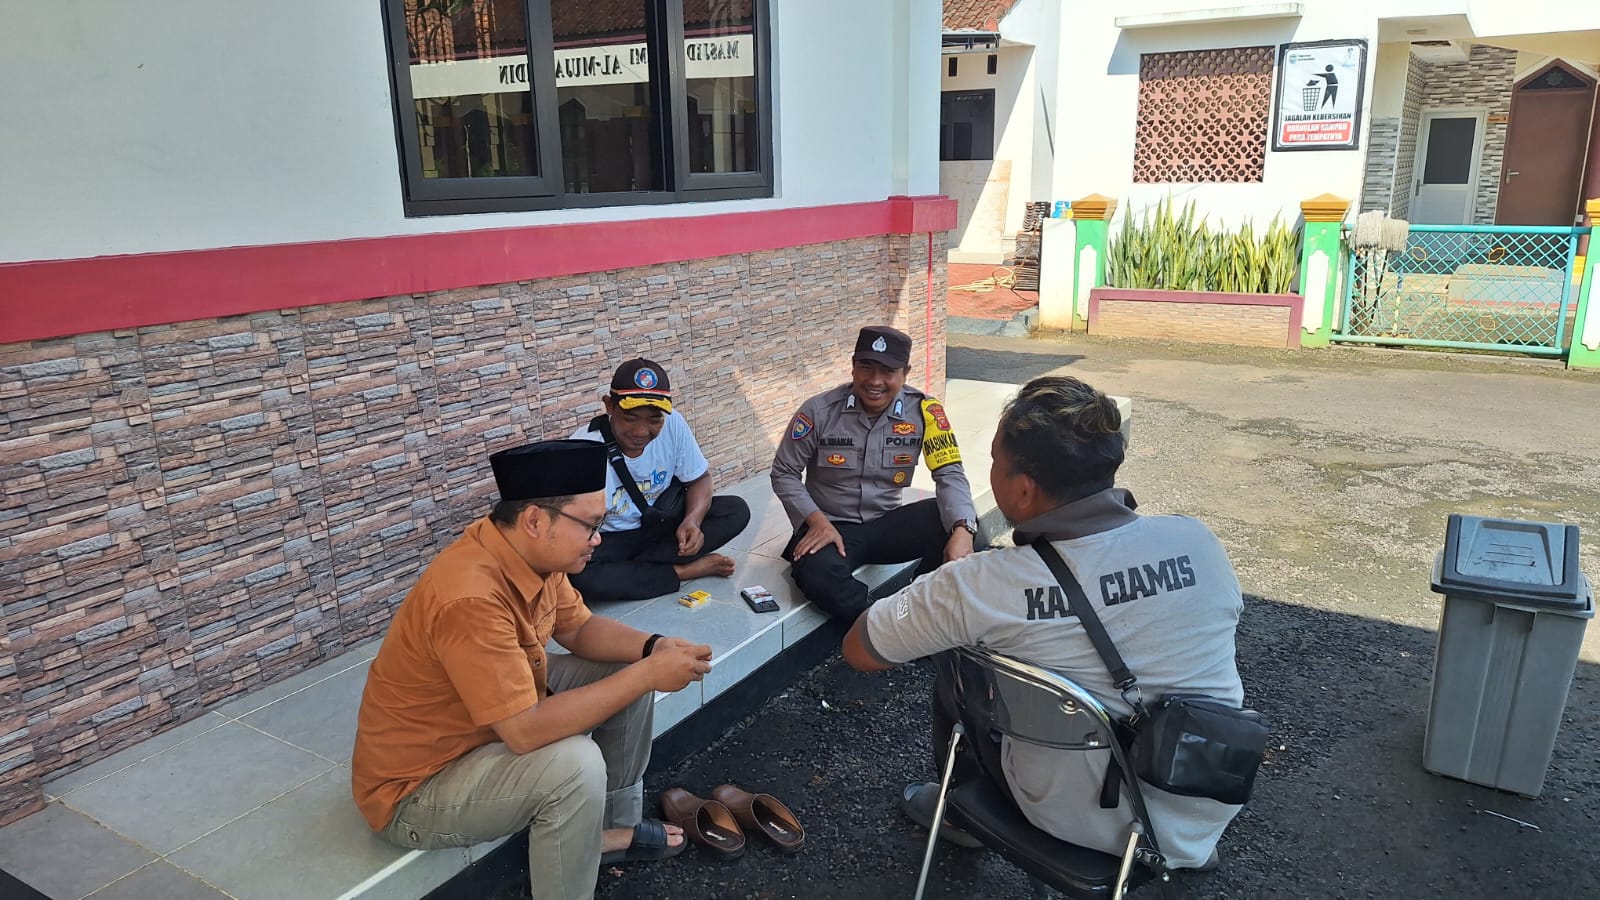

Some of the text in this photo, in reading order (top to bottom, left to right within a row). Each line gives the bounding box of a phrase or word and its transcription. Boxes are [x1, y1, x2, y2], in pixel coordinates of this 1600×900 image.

[1312, 112, 1351, 120] KEBERSIHAN
[886, 437, 920, 446] POLRI
[1024, 555, 1196, 620] KA CIAMIS
